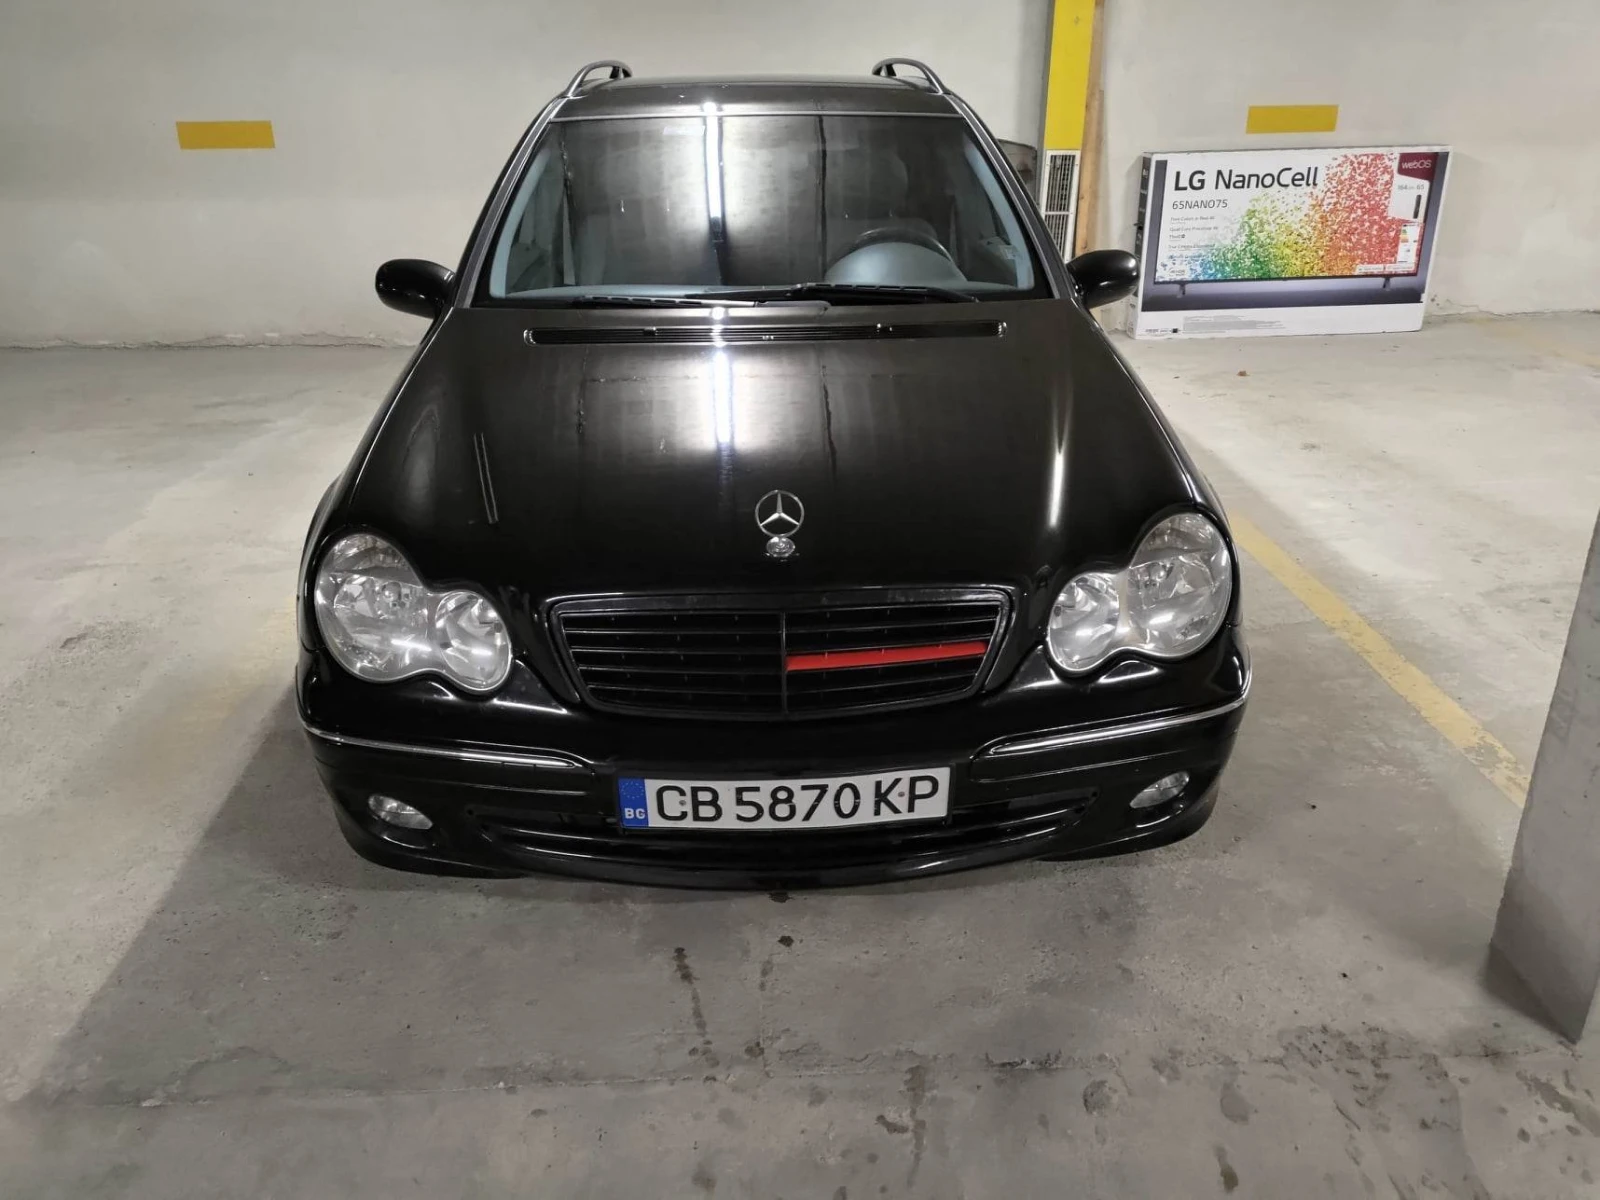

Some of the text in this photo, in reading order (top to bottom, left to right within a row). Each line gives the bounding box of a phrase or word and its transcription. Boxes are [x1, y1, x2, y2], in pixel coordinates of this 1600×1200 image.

[1401, 160, 1432, 169] webOS
[1174, 170, 1206, 191] LG
[1215, 166, 1318, 190] NanoCell
[1172, 199, 1228, 210] 65NANO75
[655, 774, 940, 822] CB 5870 KP
[624, 807, 646, 820] BG
